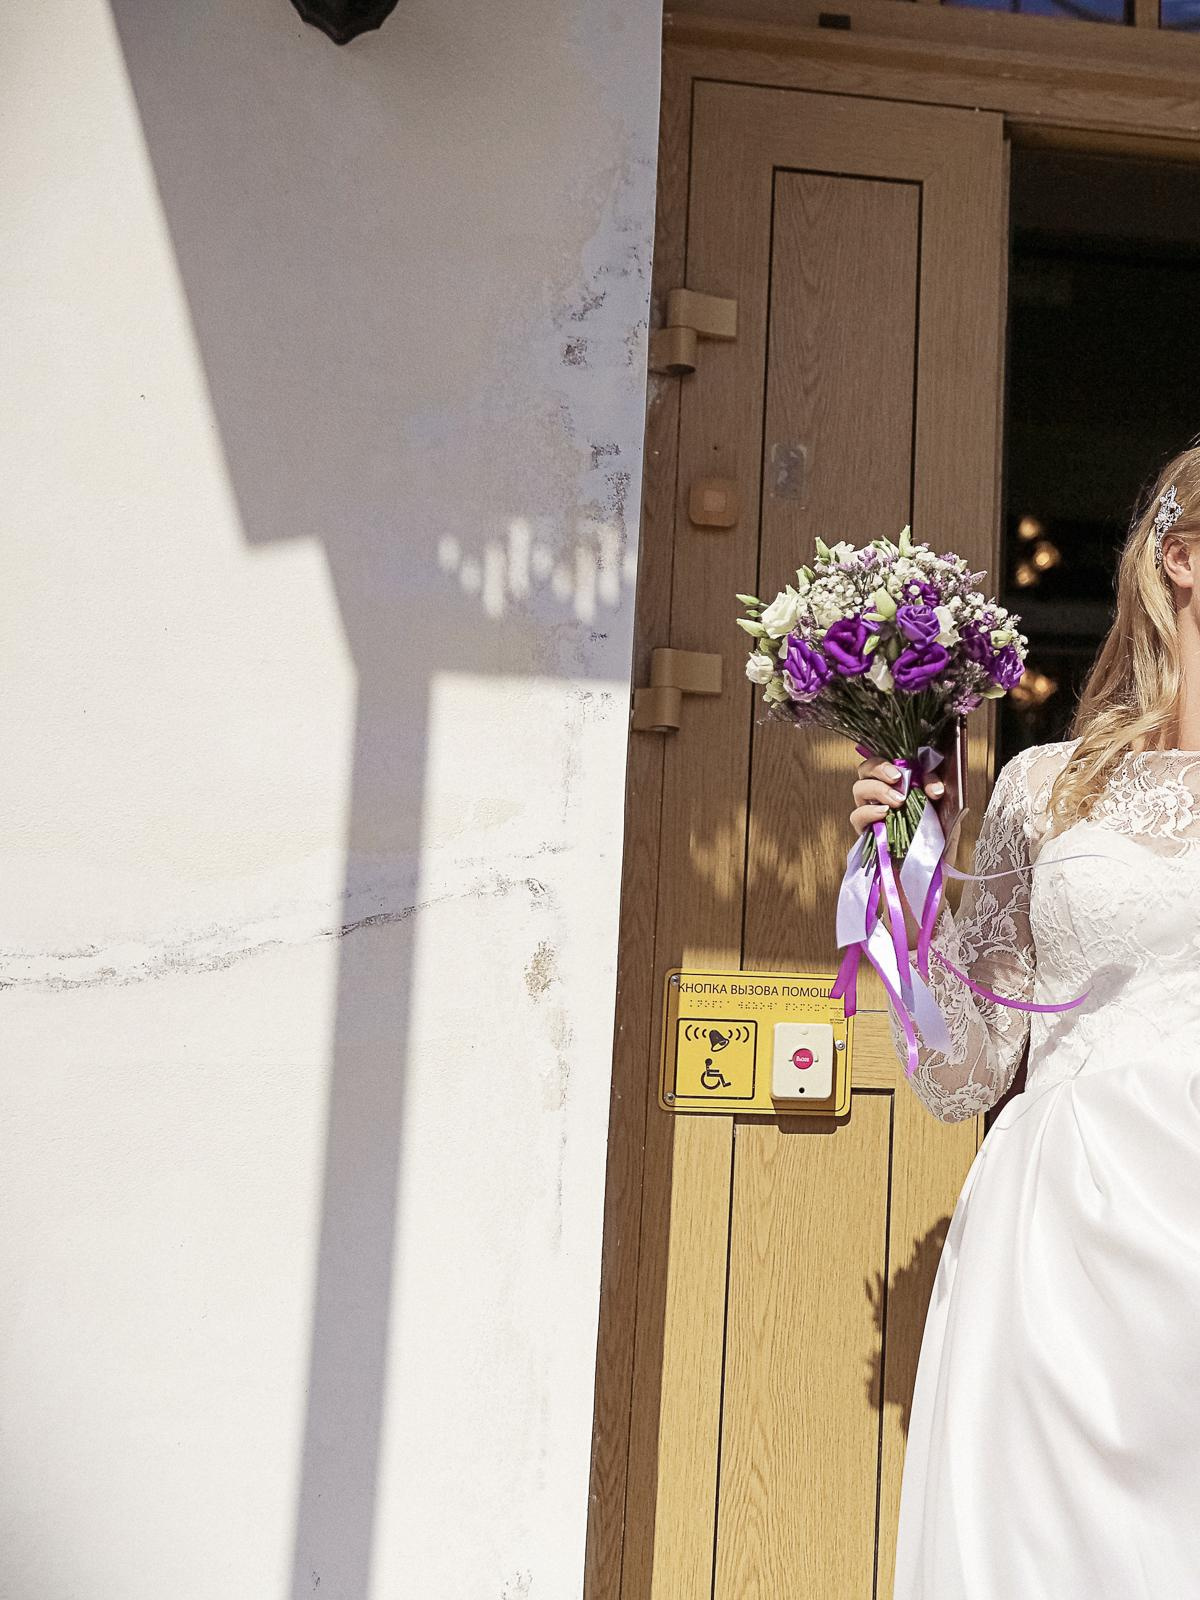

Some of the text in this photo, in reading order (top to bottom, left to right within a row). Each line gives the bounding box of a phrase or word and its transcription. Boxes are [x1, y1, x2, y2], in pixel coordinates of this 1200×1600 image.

[677, 982, 831, 1000] КНОПКА ВЫЗОВА ПОМОЩ
